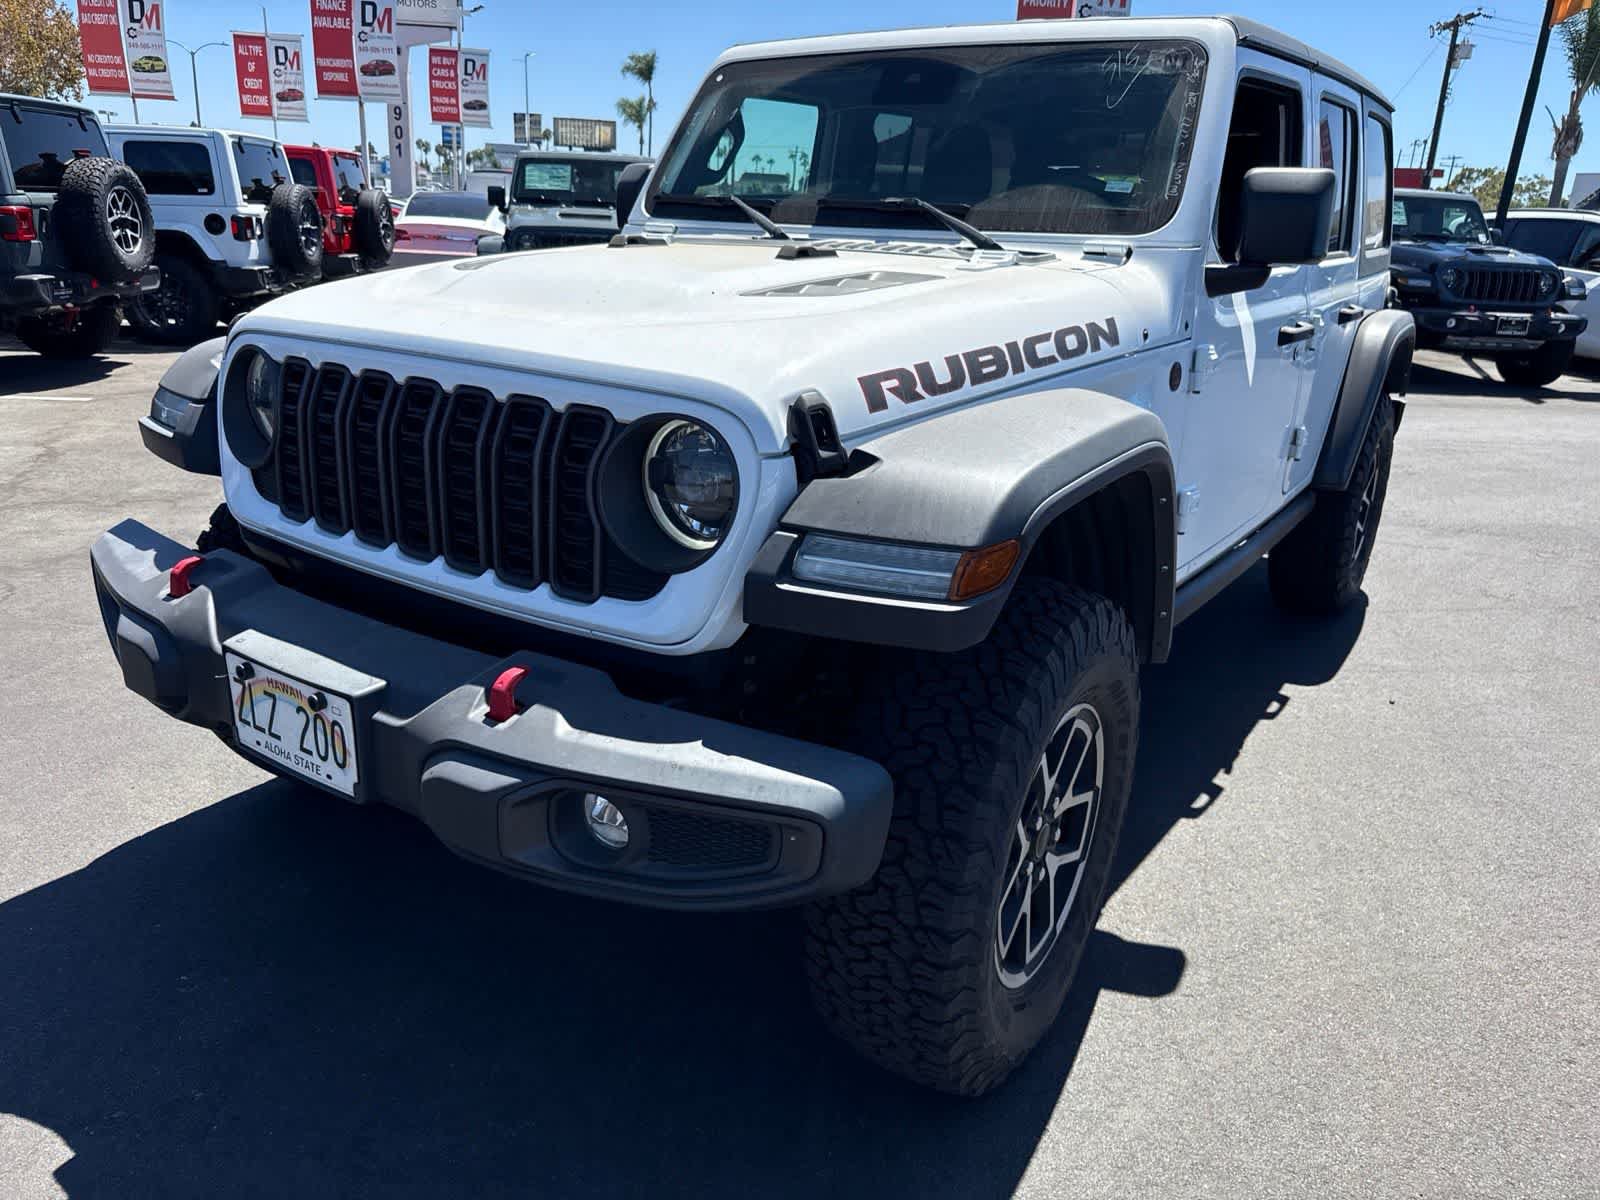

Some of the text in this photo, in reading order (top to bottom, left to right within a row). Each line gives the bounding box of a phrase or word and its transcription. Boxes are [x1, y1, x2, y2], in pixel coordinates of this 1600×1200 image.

[316, 0, 347, 12] FINANCE
[397, 0, 438, 9] MOTORS
[1022, 0, 1068, 8] PRIORITY
[313, 15, 351, 30] AVAILABLE
[238, 44, 263, 57] ALL TYPE
[247, 61, 256, 73] OF
[431, 56, 456, 66] WE BUY
[432, 67, 449, 77] CARS
[243, 77, 263, 90] CREDIT
[432, 80, 457, 90] TRUCKS
[242, 94, 269, 106] WELCOME
[432, 105, 458, 114] ACCEPTED
[857, 317, 1120, 414] RUBICON
[296, 705, 347, 770] 200
[264, 740, 322, 777] ALOHA STATE
